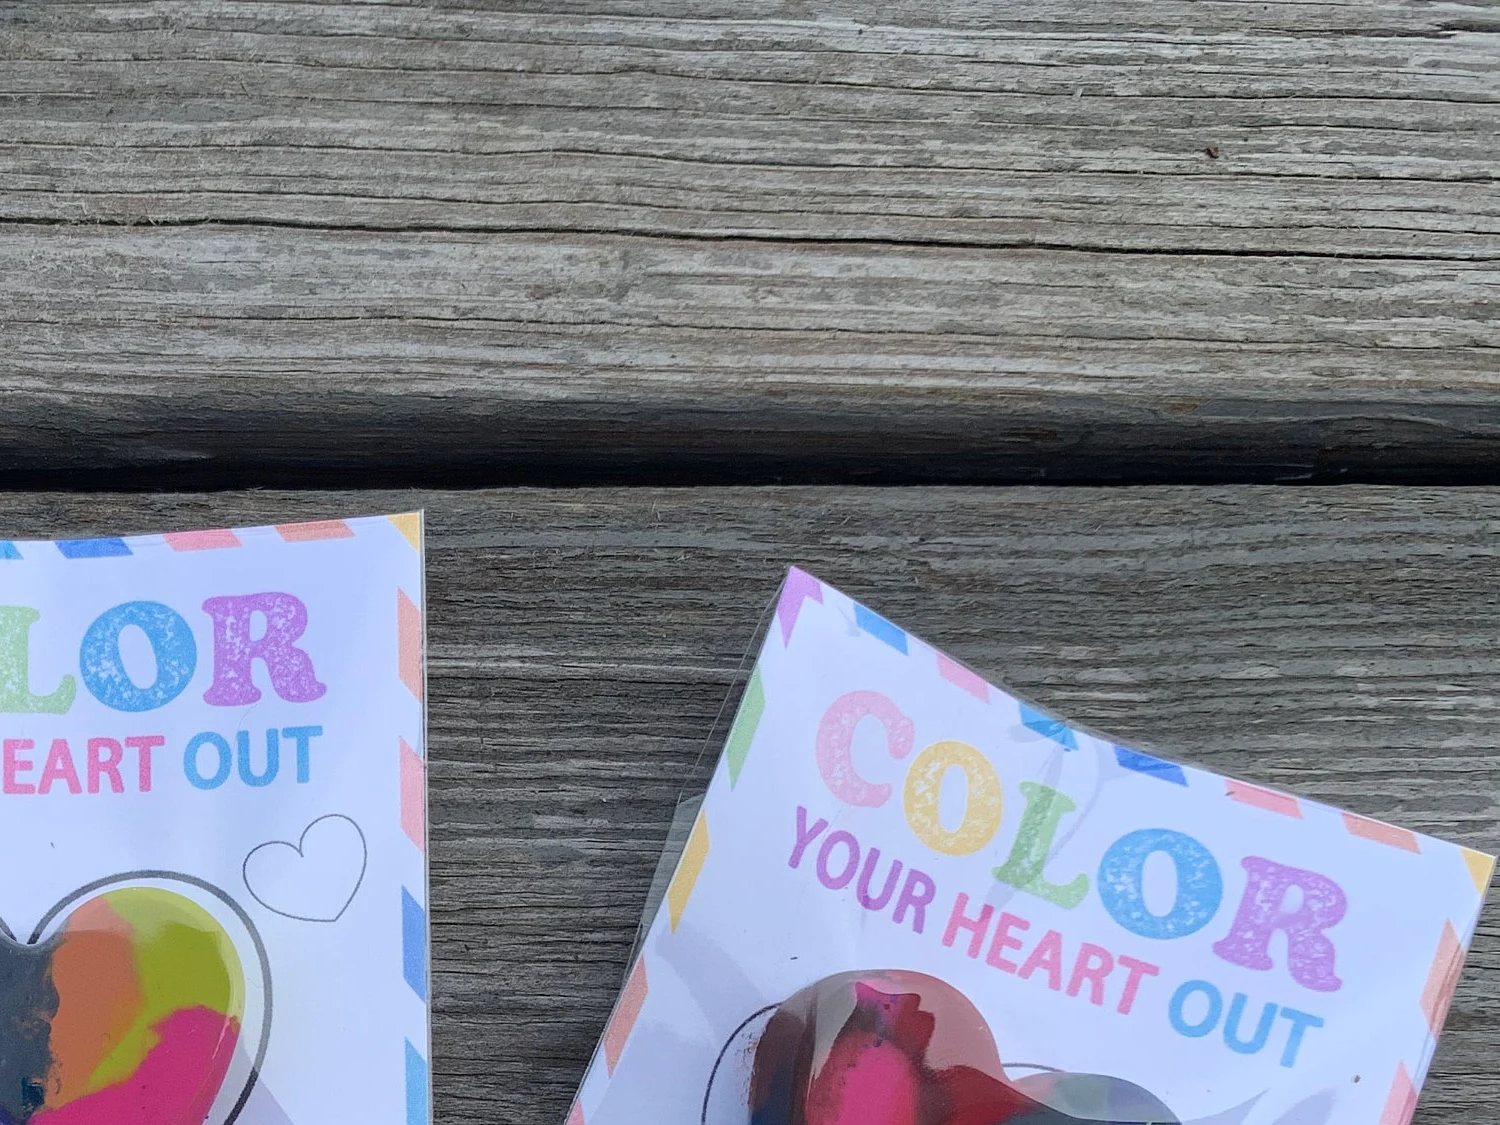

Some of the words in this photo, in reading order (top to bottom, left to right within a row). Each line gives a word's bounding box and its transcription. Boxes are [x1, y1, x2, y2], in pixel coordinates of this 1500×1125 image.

[183, 725, 323, 787] OUT
[816, 690, 1348, 993] COLOR
[787, 806, 936, 933] YOUR
[941, 892, 1159, 1015] HEART
[1168, 979, 1324, 1068] OUT
